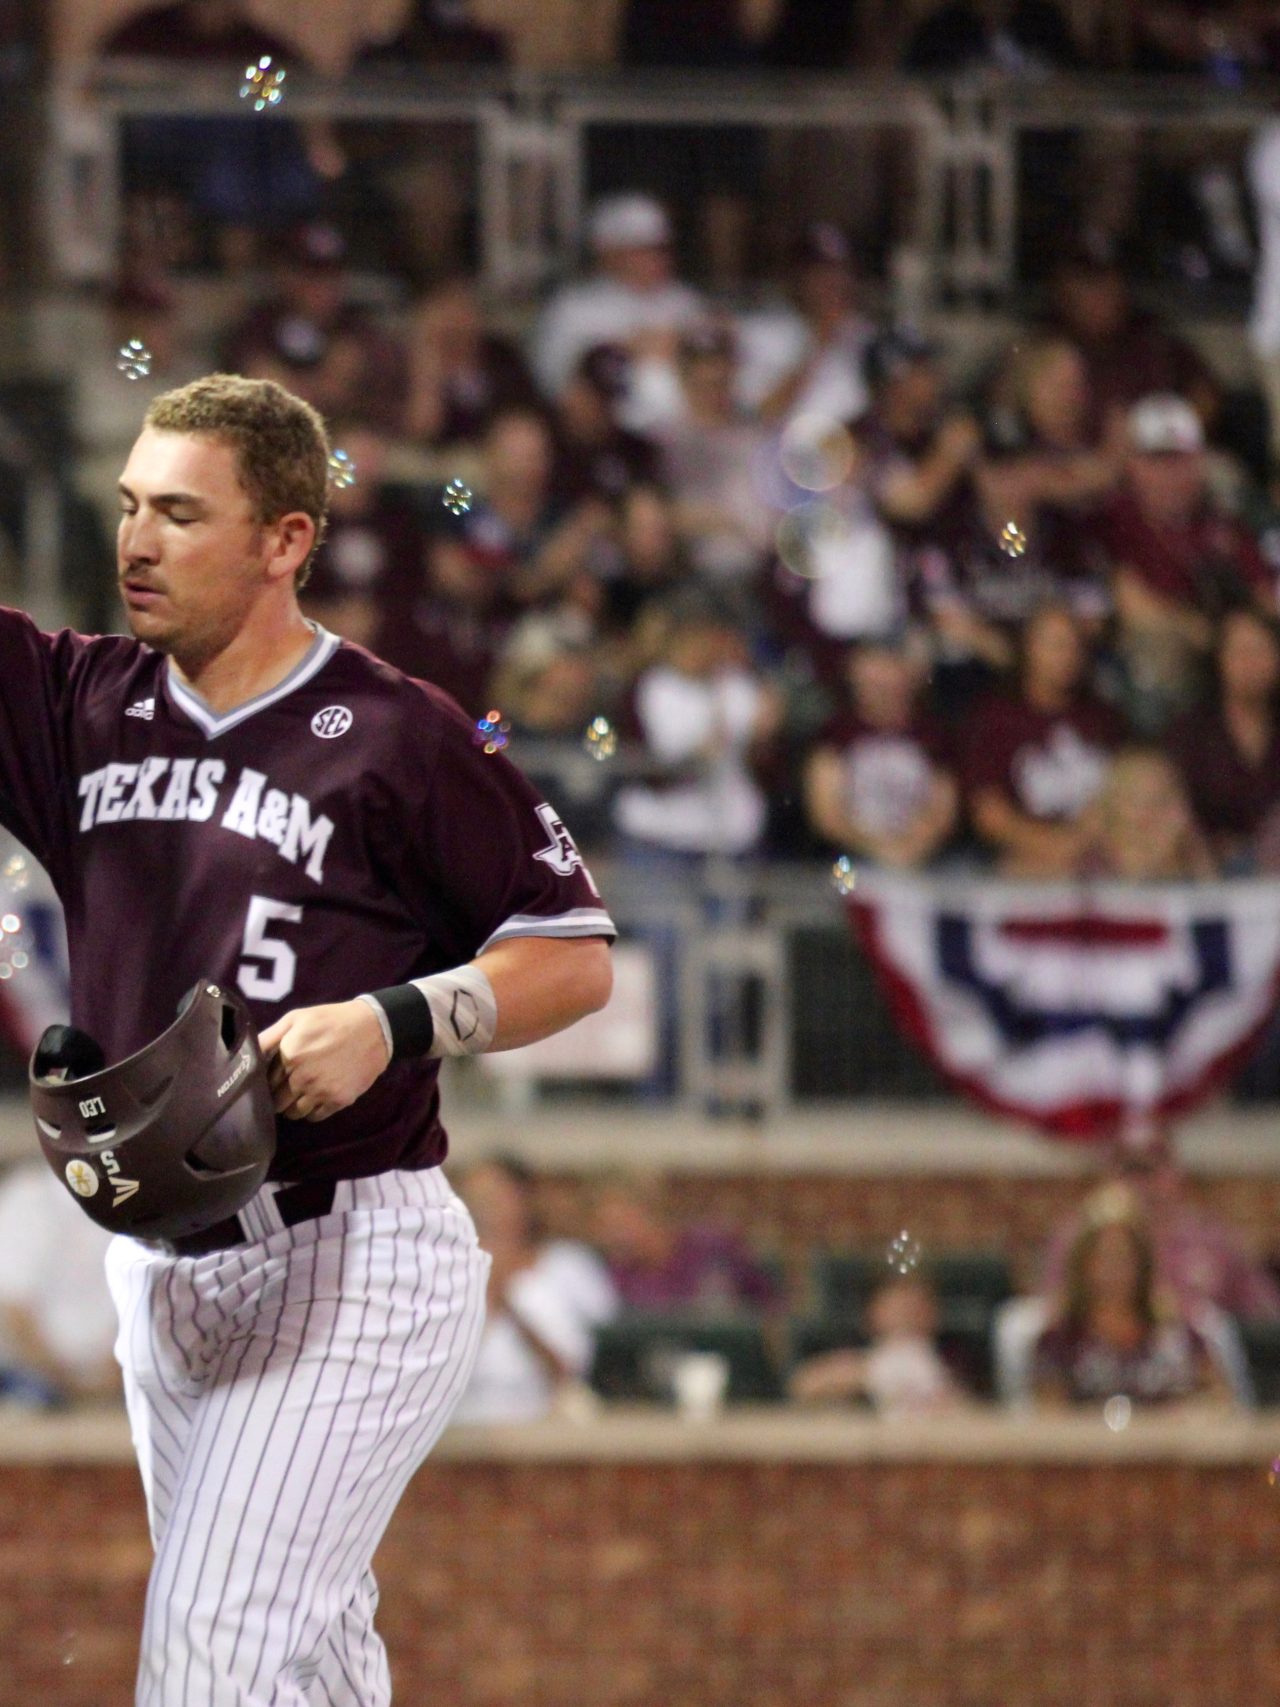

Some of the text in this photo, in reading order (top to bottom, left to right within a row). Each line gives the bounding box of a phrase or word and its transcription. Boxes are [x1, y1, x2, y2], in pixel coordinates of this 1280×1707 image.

[314, 708, 349, 736] SEC
[78, 756, 335, 885] TEXAS A&M
[237, 895, 304, 1003] 5
[78, 1096, 106, 1118] LEO
